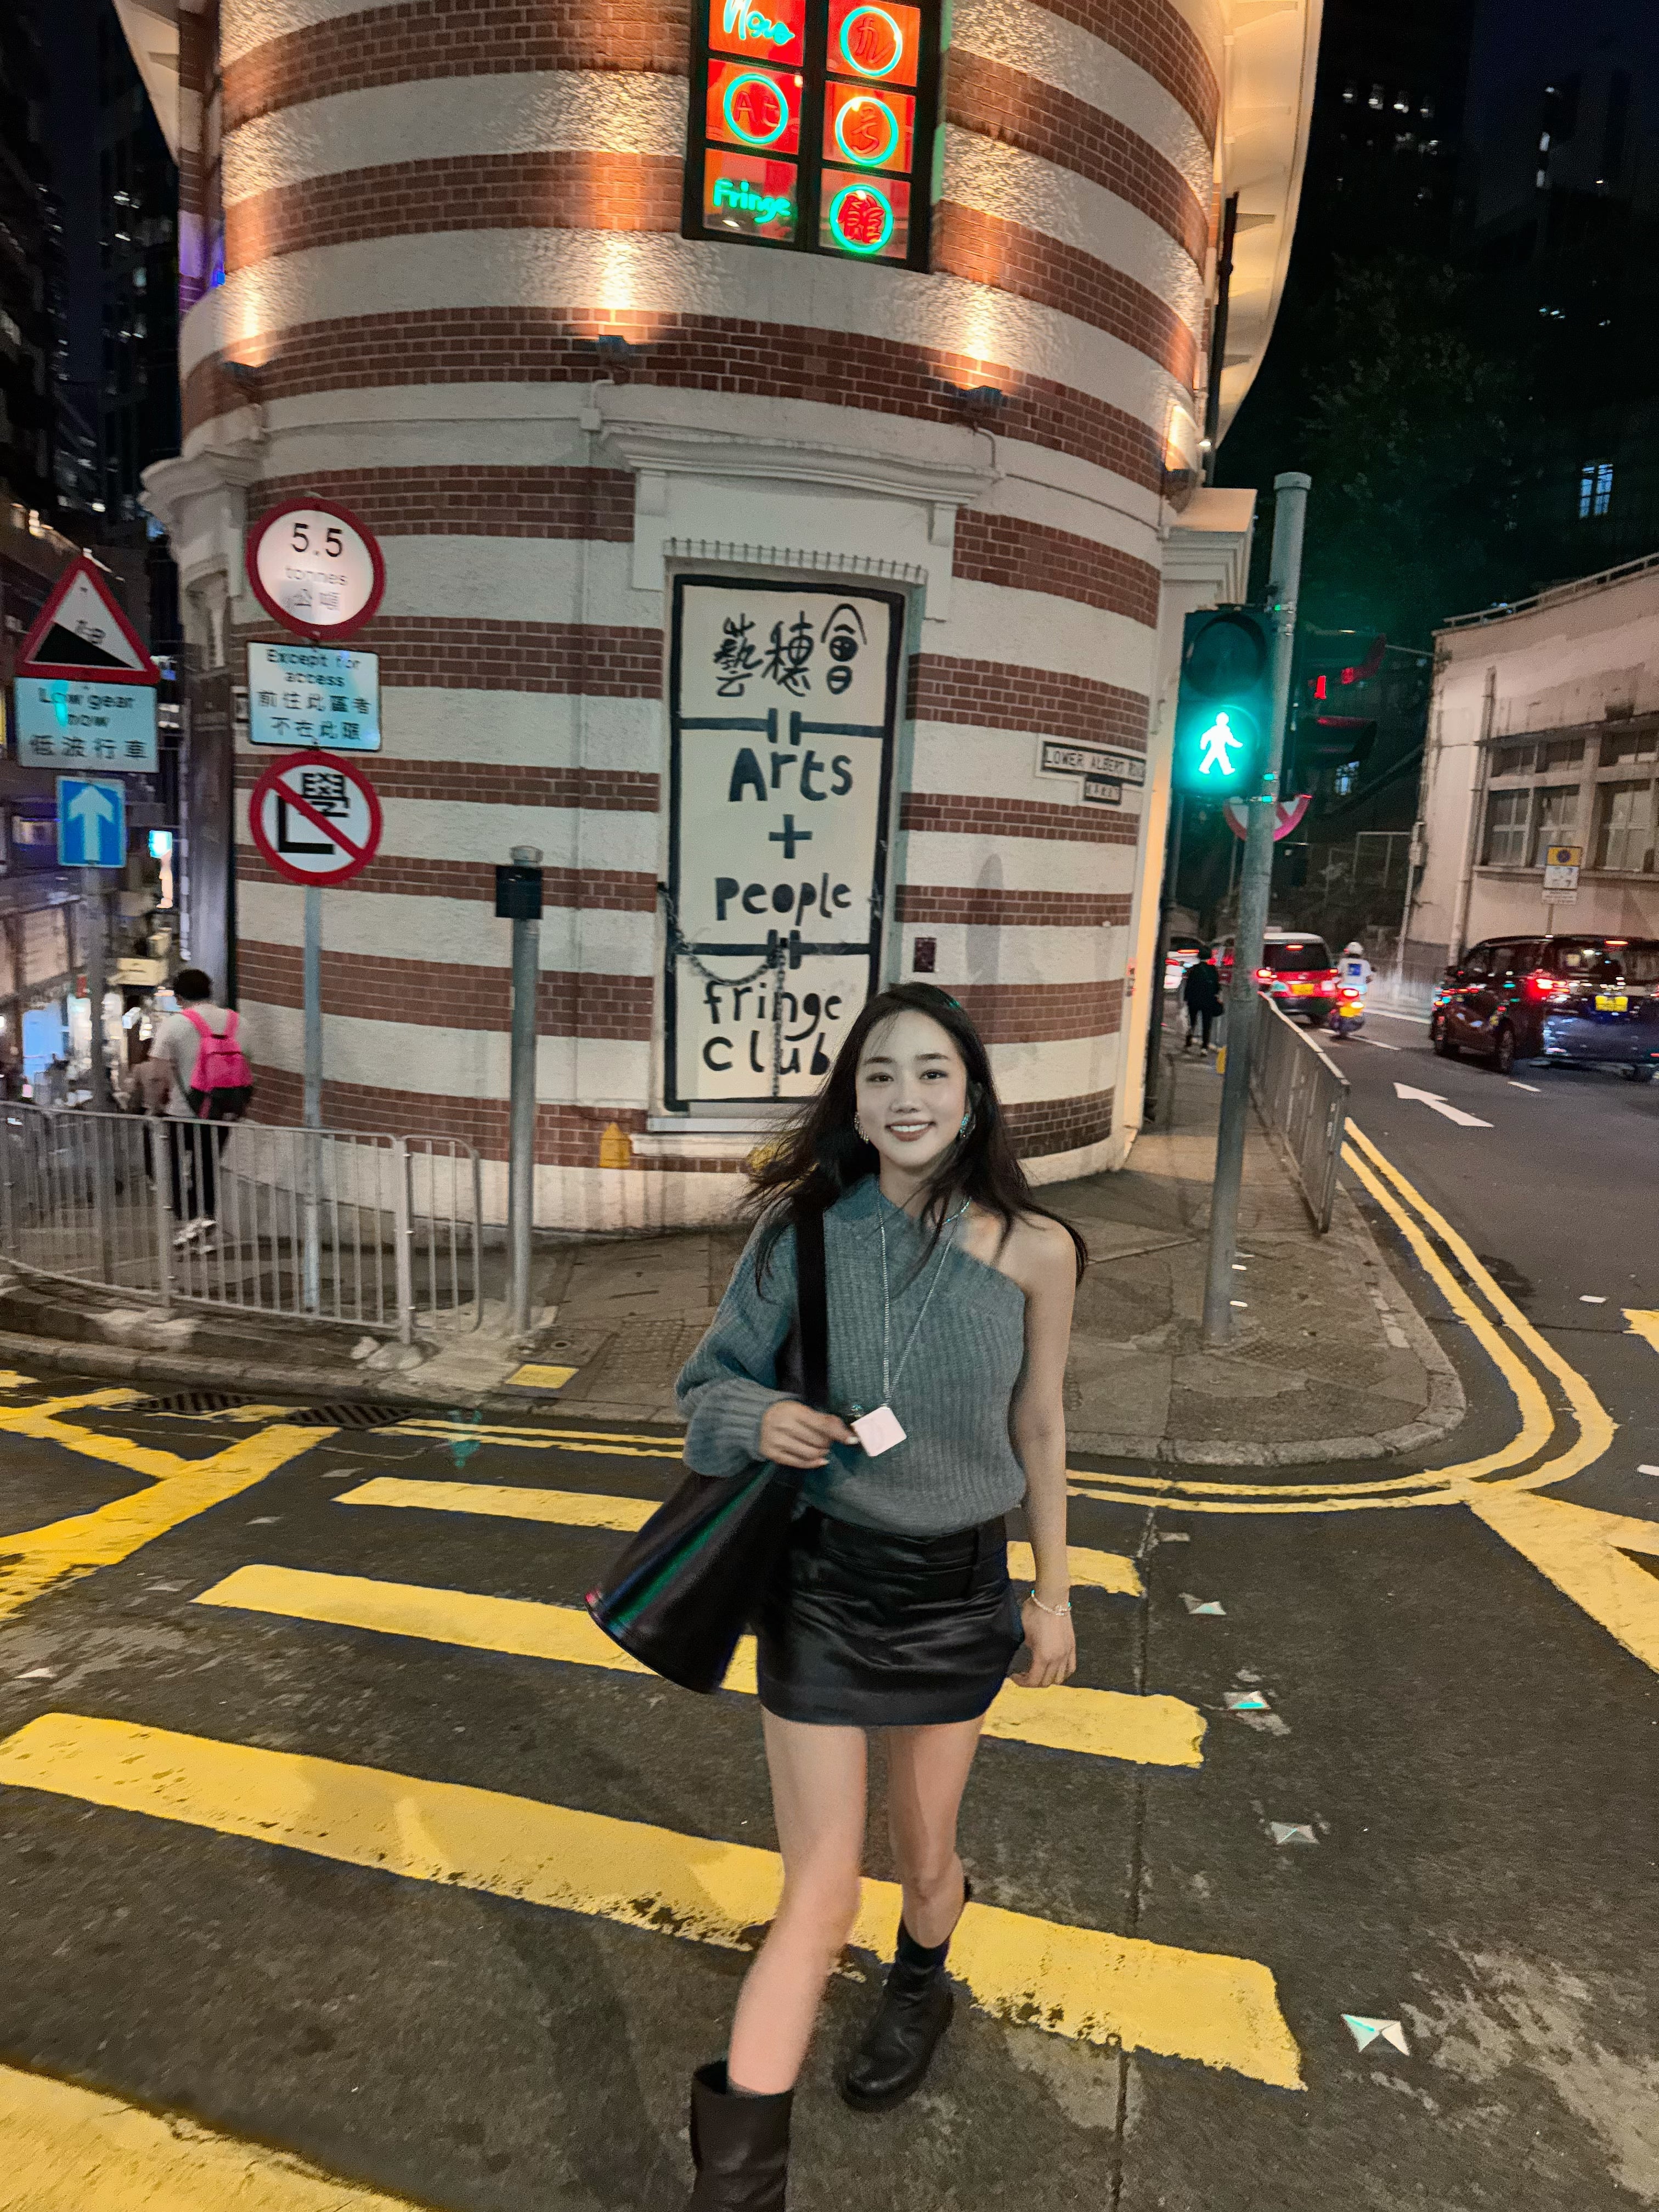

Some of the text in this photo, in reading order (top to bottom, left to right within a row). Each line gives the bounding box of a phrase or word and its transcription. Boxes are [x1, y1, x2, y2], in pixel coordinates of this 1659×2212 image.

[713, 178, 791, 224] Fringe
[290, 523, 343, 557] 5.5
[266, 648, 360, 669] Except for
[285, 672, 345, 687] access
[38, 687, 134, 710] Low gear
[728, 747, 854, 802] Arts
[277, 794, 335, 854] L
